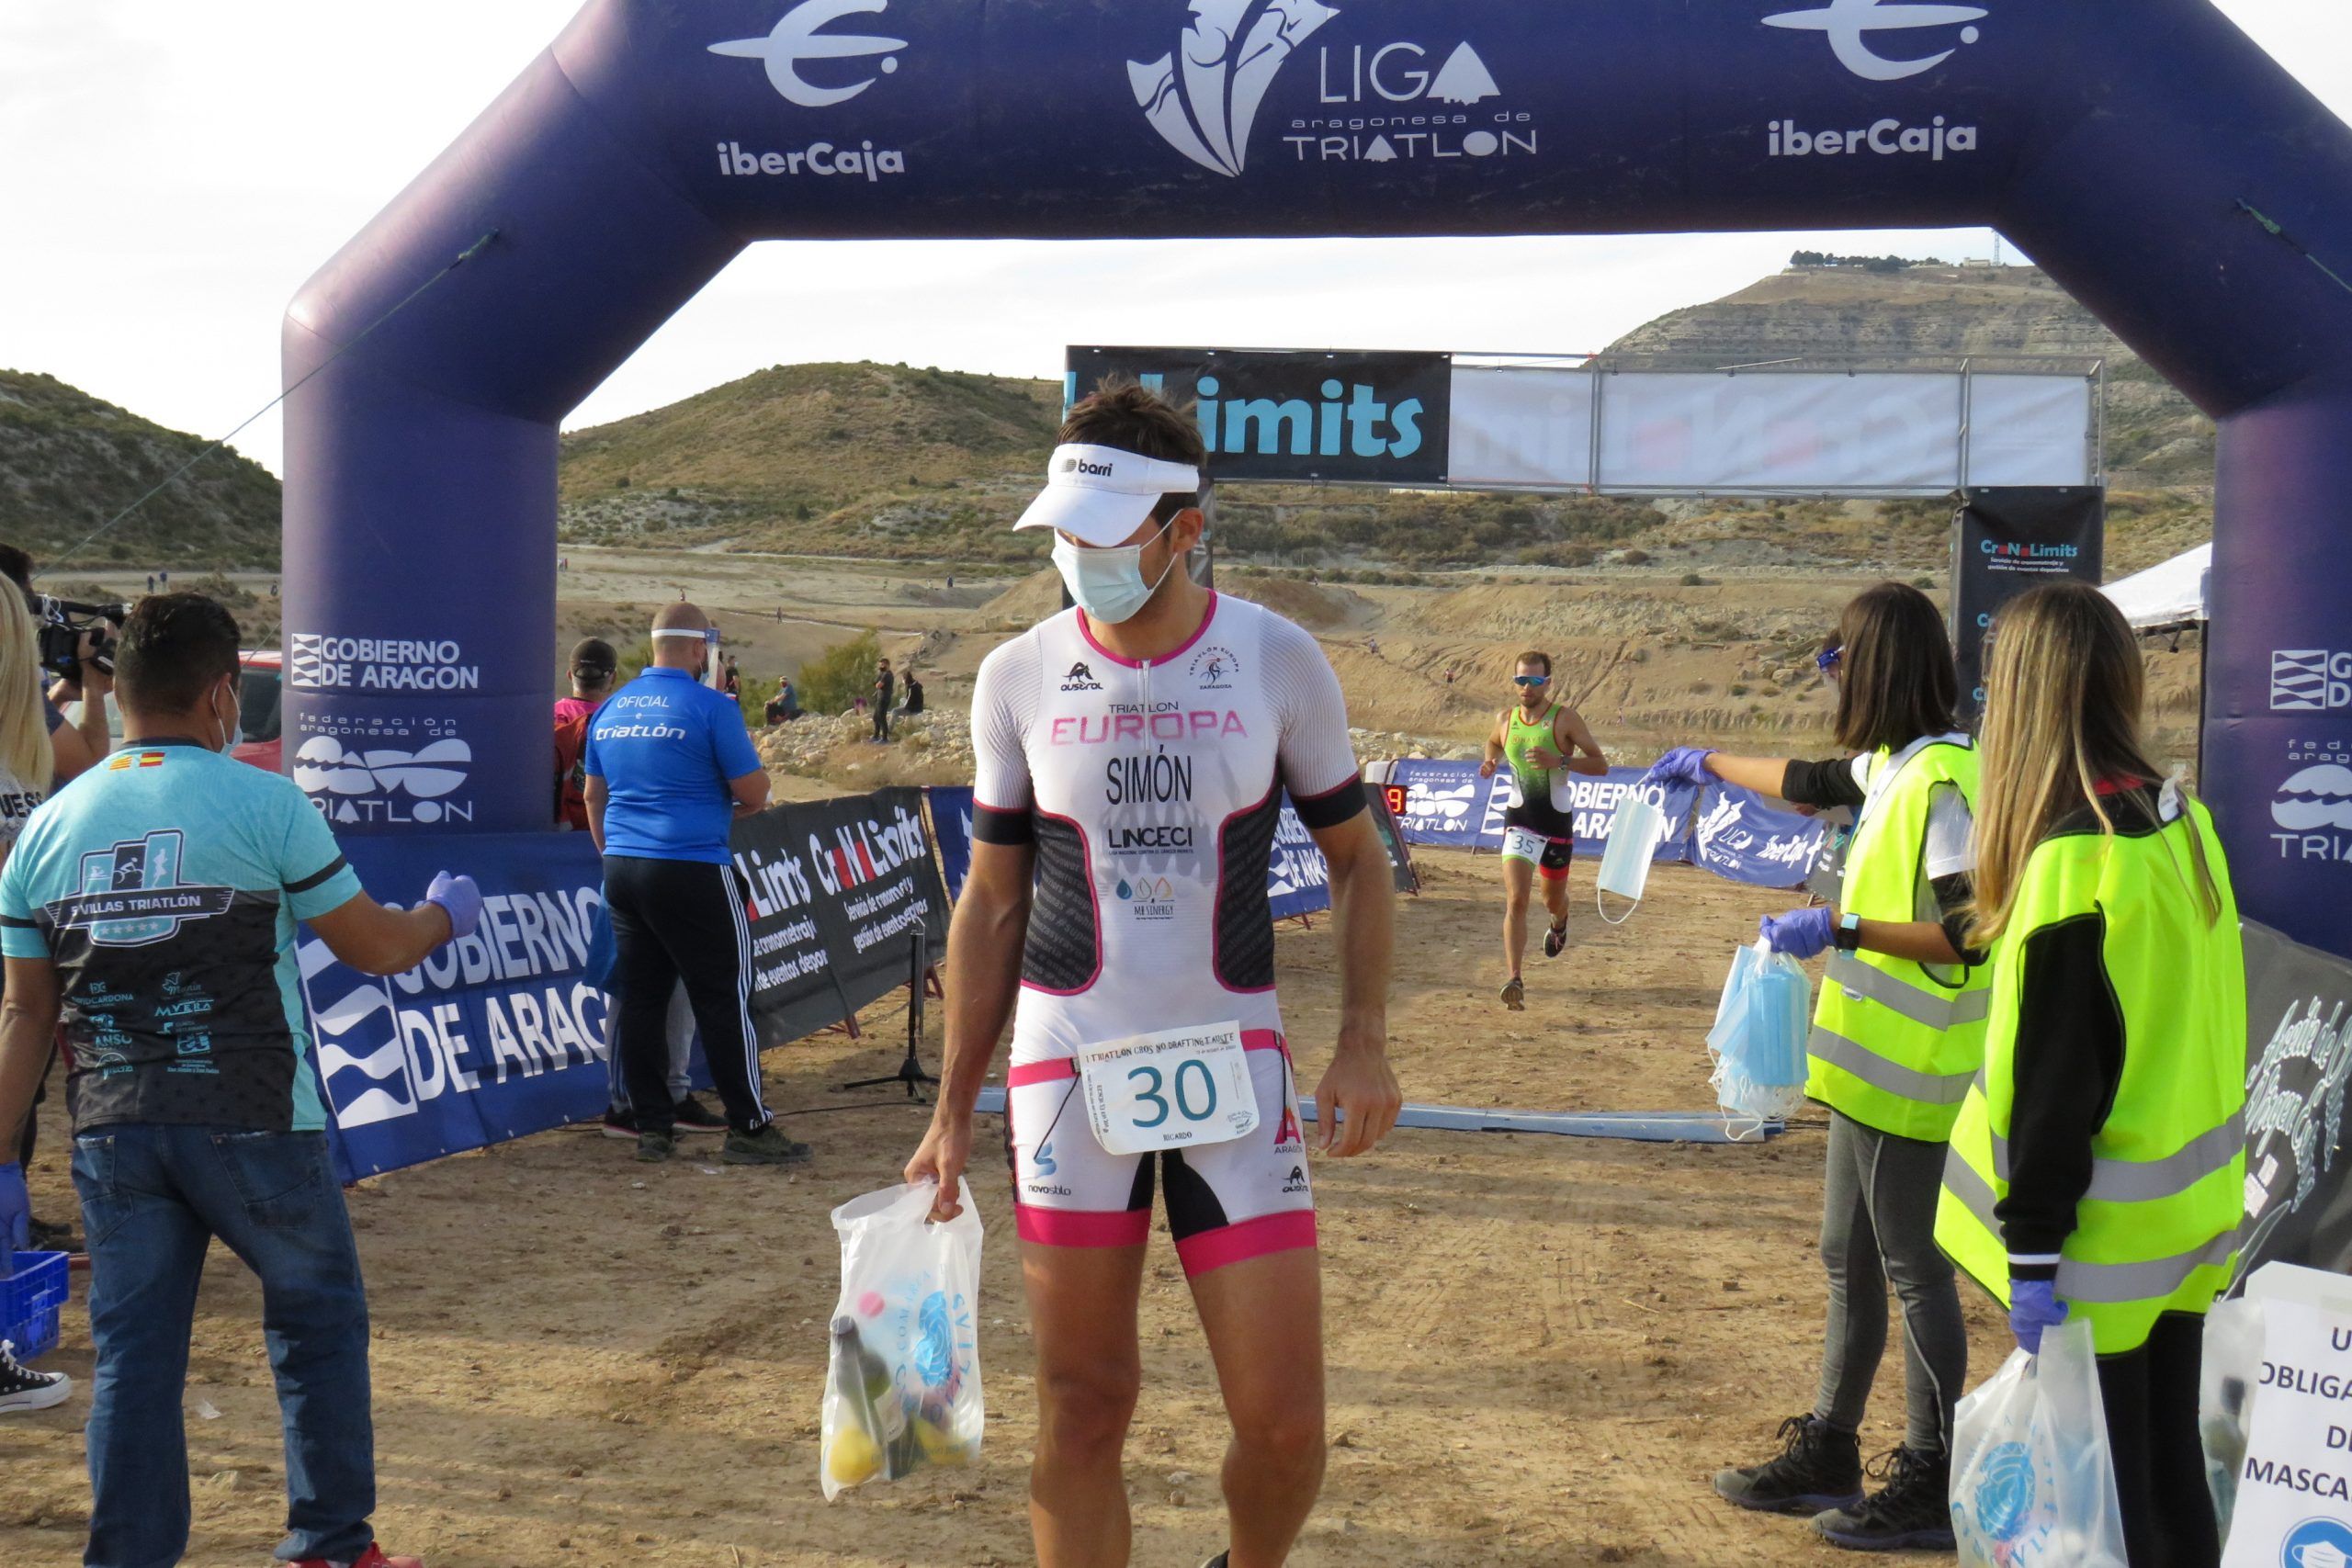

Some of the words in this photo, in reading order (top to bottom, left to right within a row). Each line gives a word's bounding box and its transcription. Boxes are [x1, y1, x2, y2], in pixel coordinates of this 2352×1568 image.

[1320, 40, 1501, 106] LIGA
[1292, 114, 1467, 130] aragonesa
[1494, 111, 1532, 123] de
[1283, 130, 1537, 163] TRIATLON
[1769, 115, 1976, 161] iberCaja
[718, 141, 906, 182] iberCaja
[1078, 458, 1114, 477] barri
[322, 637, 460, 664] GOBIERNO
[322, 663, 352, 687] DE
[360, 666, 479, 689] ARAGON
[616, 695, 670, 709] OFICIAL
[300, 712, 457, 727] federación
[300, 724, 410, 736] aragonesa
[429, 728, 457, 736] de
[595, 723, 686, 741] triatlón
[1050, 710, 1250, 747] EUROPA
[1106, 744, 1192, 806] SIMÓN
[310, 797, 472, 824] RIATLON
[1387, 788, 1402, 813] 9
[1108, 826, 1193, 849] LINCECI
[1512, 834, 1536, 854] 35
[128, 893, 201, 911] TRIATLÓN
[797, 947, 829, 975] depor
[399, 1003, 481, 1101] DE
[485, 982, 610, 1085] ARAG
[1091, 1048, 1133, 1063] TRIATLON
[1127, 1059, 1217, 1128] 30
[1162, 1131, 1193, 1142] RICARDO
[2245, 1456, 2352, 1503] MASCA
